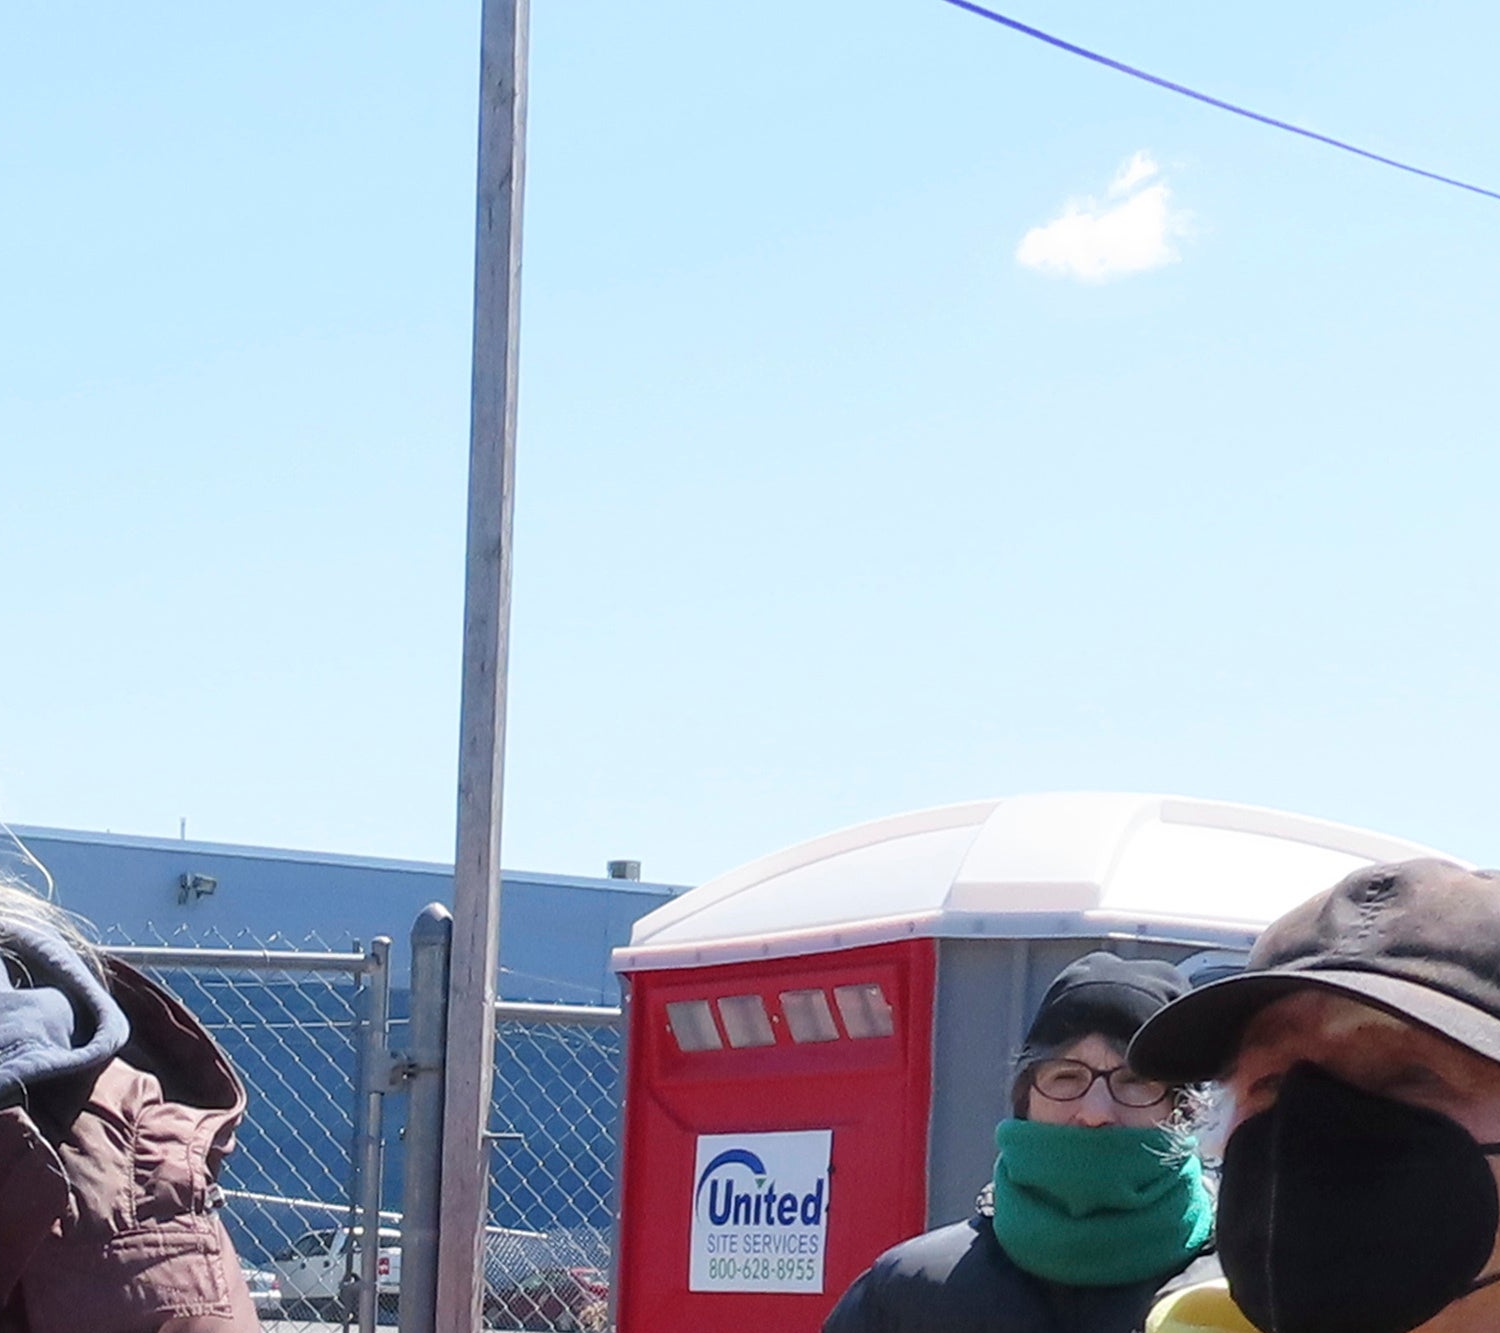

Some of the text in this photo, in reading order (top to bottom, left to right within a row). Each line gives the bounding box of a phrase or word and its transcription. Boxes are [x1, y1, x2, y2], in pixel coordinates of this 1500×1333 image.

[708, 1177, 825, 1227] United
[707, 1233, 820, 1255] SITE SERVICES
[709, 1257, 815, 1281] 800-628-8955
